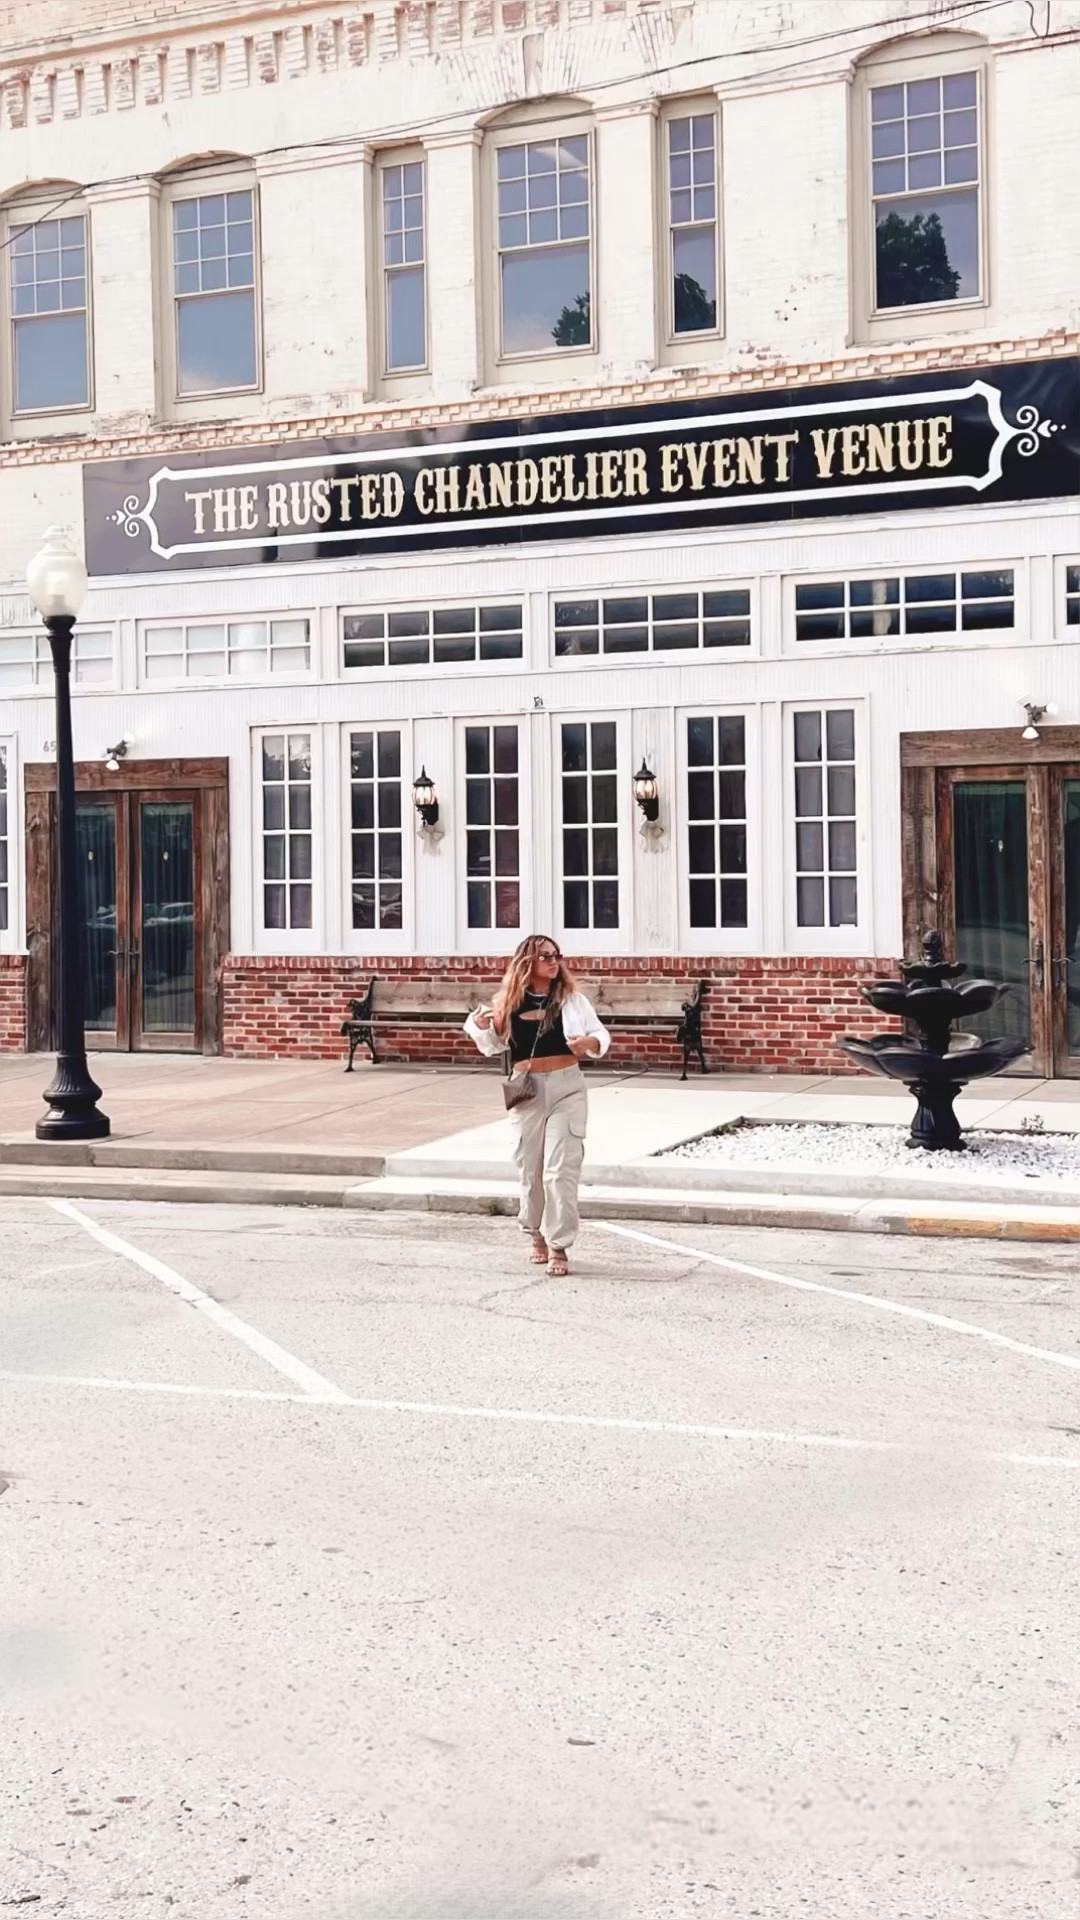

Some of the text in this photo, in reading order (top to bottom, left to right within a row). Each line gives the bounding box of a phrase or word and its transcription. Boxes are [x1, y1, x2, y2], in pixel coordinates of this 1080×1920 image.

[186, 416, 953, 534] THE RUSTED CHANDELIER EVENT VENUE
